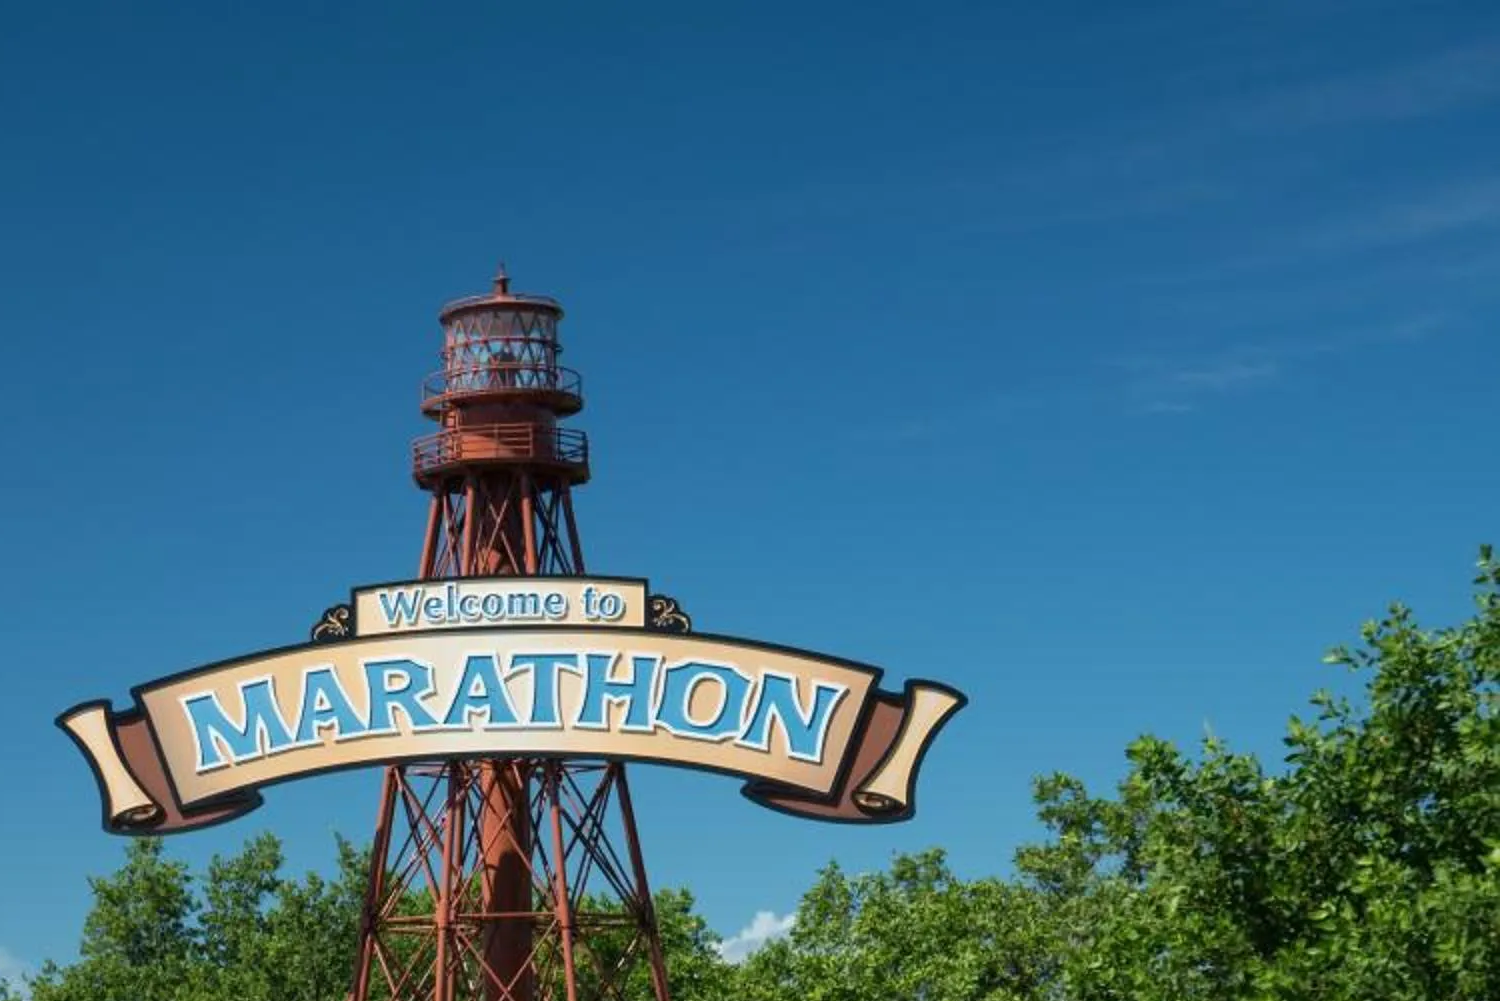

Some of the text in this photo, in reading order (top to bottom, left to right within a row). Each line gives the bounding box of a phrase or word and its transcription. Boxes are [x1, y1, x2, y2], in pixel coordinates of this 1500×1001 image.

[379, 583, 625, 624] Welcome to
[179, 651, 847, 774] MARATHON
